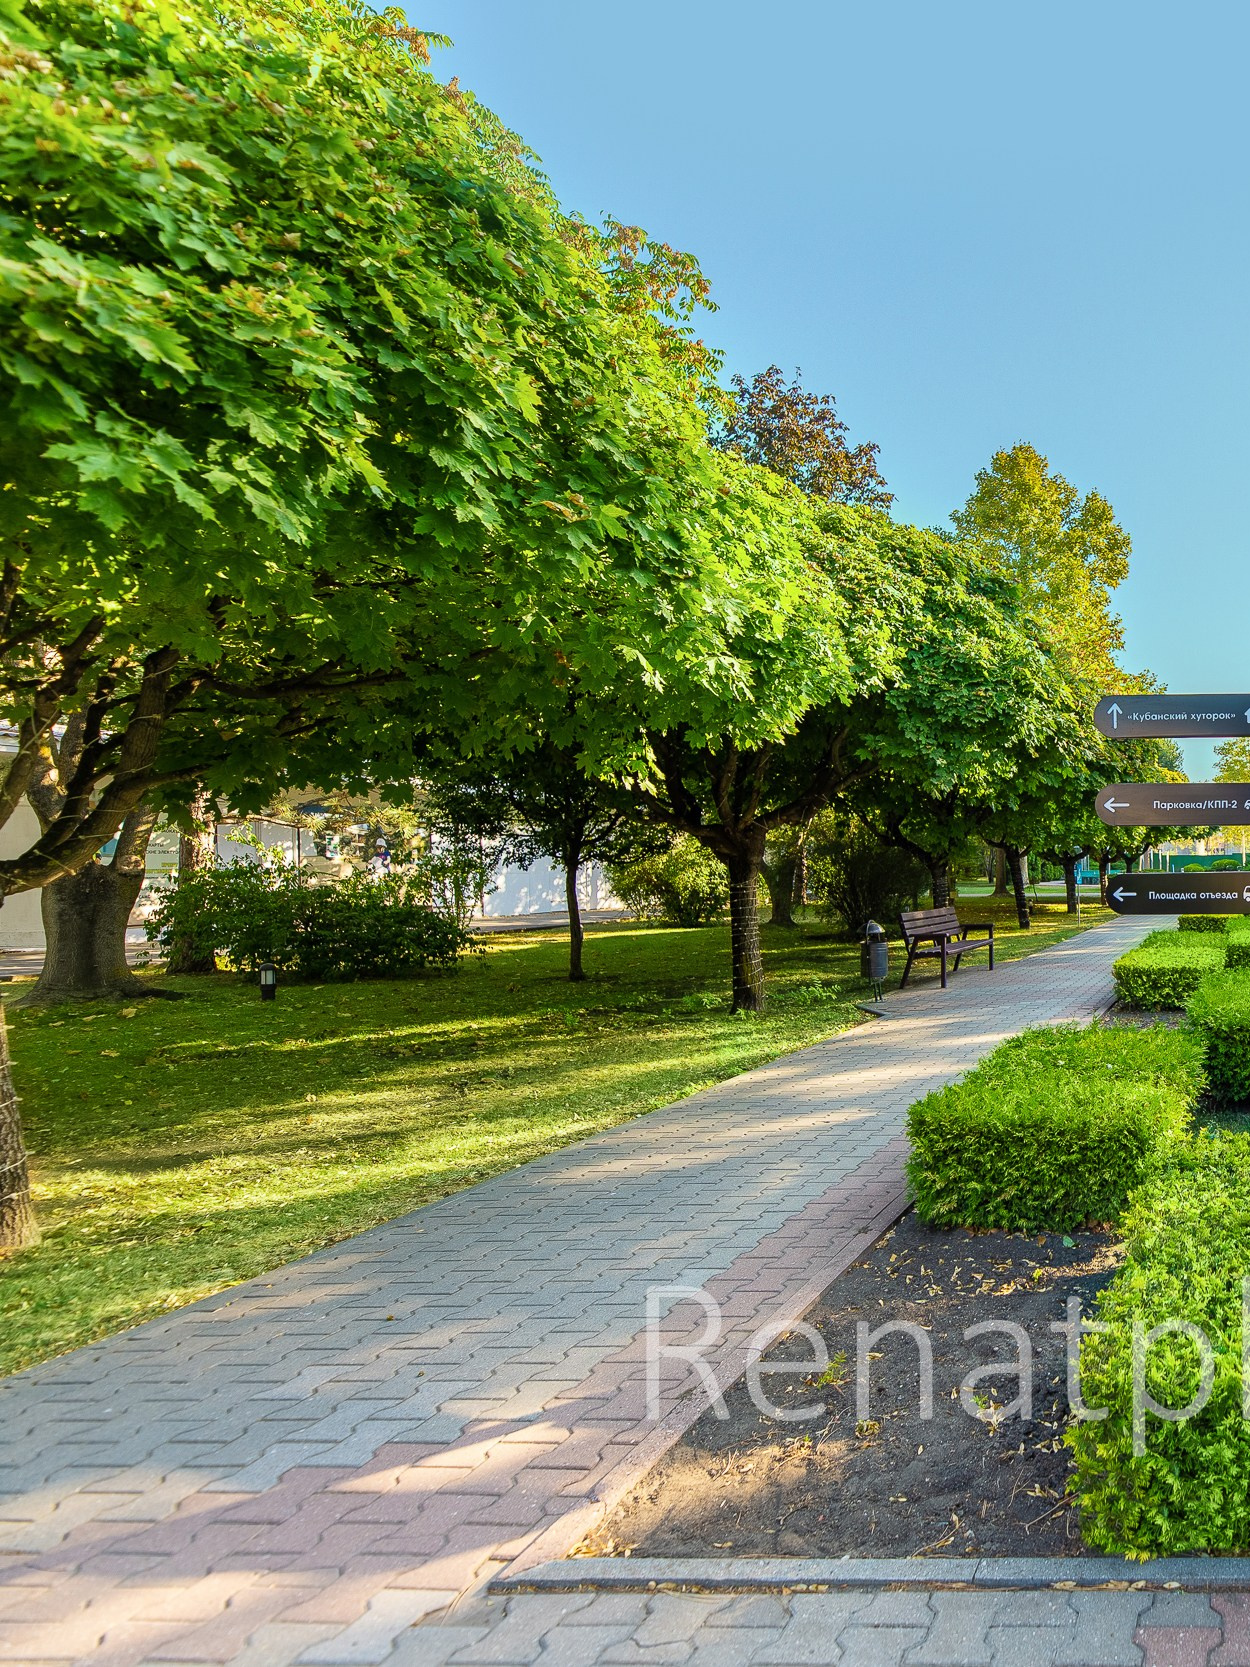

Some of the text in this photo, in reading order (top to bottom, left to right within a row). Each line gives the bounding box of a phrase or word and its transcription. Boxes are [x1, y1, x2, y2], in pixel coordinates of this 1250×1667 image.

[1127, 711, 1236, 723] «Кубанский хуторок»
[1153, 799, 1238, 811] Парковка/КПП-2
[1148, 891, 1238, 901] Площадка отъезда
